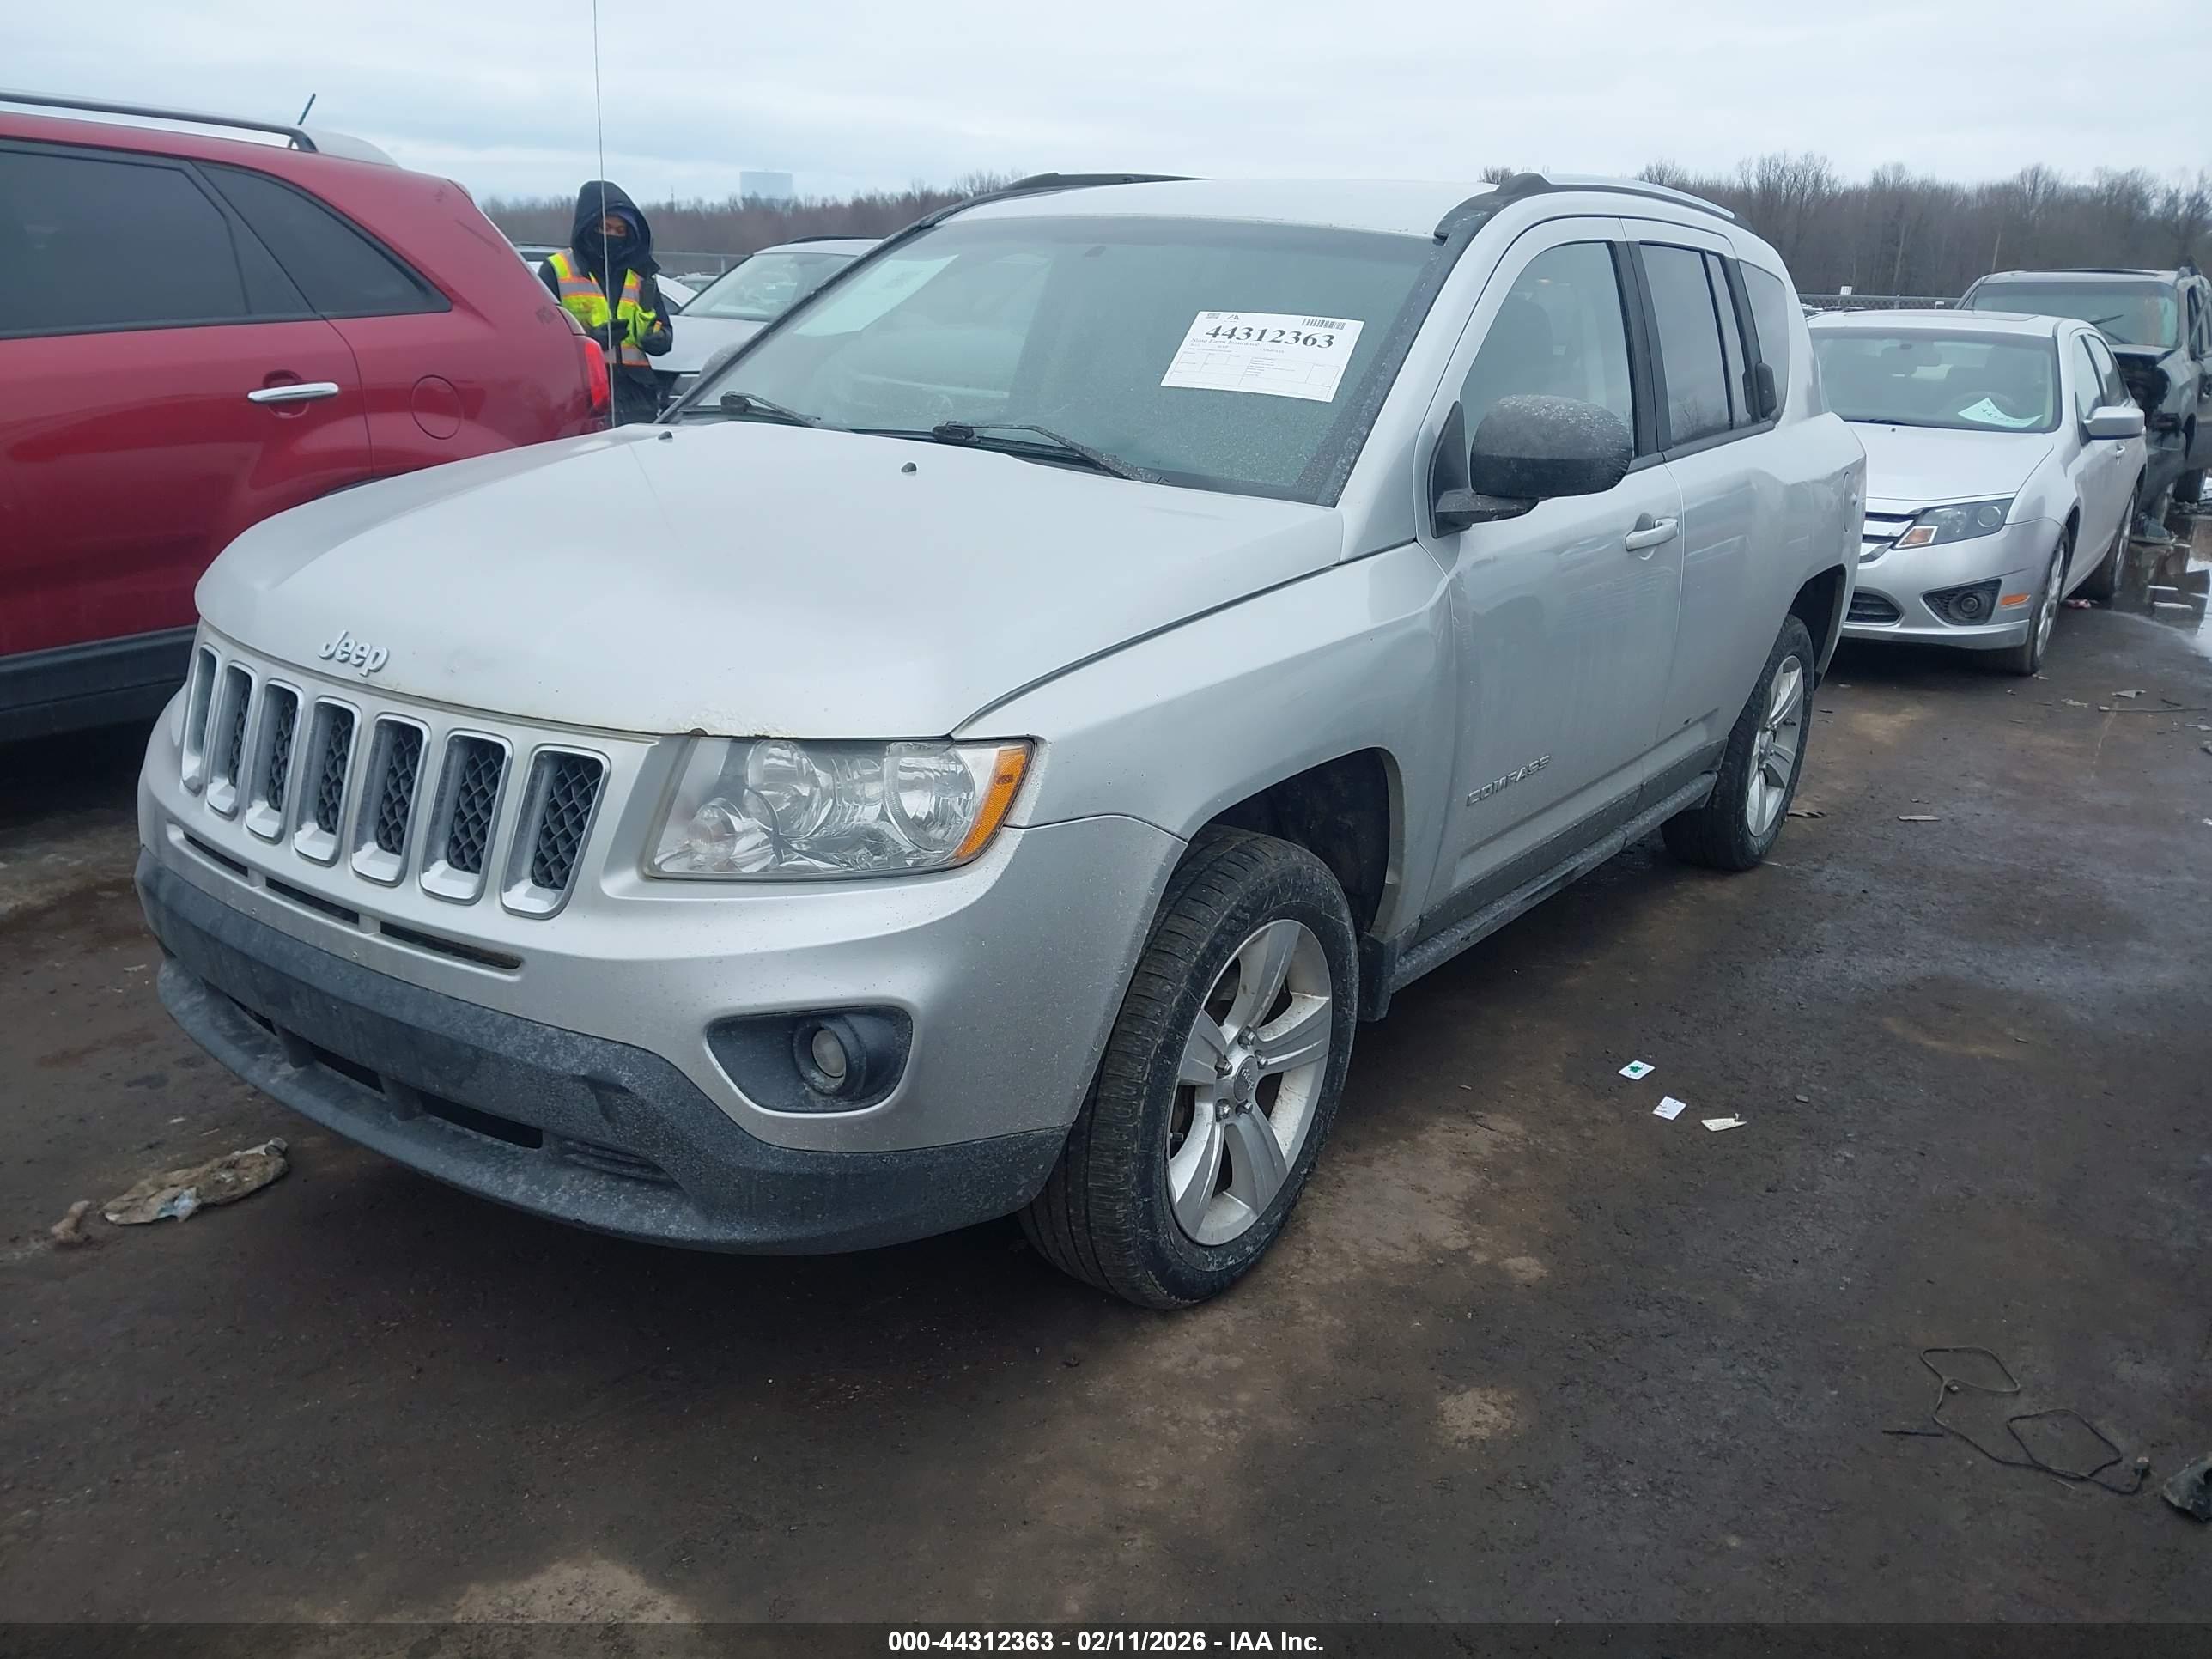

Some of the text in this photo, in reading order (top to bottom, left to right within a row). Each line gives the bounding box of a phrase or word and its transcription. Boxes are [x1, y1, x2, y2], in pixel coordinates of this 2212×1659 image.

[1206, 325, 1334, 349] 44312363
[317, 629, 389, 678] Jeep
[1466, 755, 1551, 806] COMPASS
